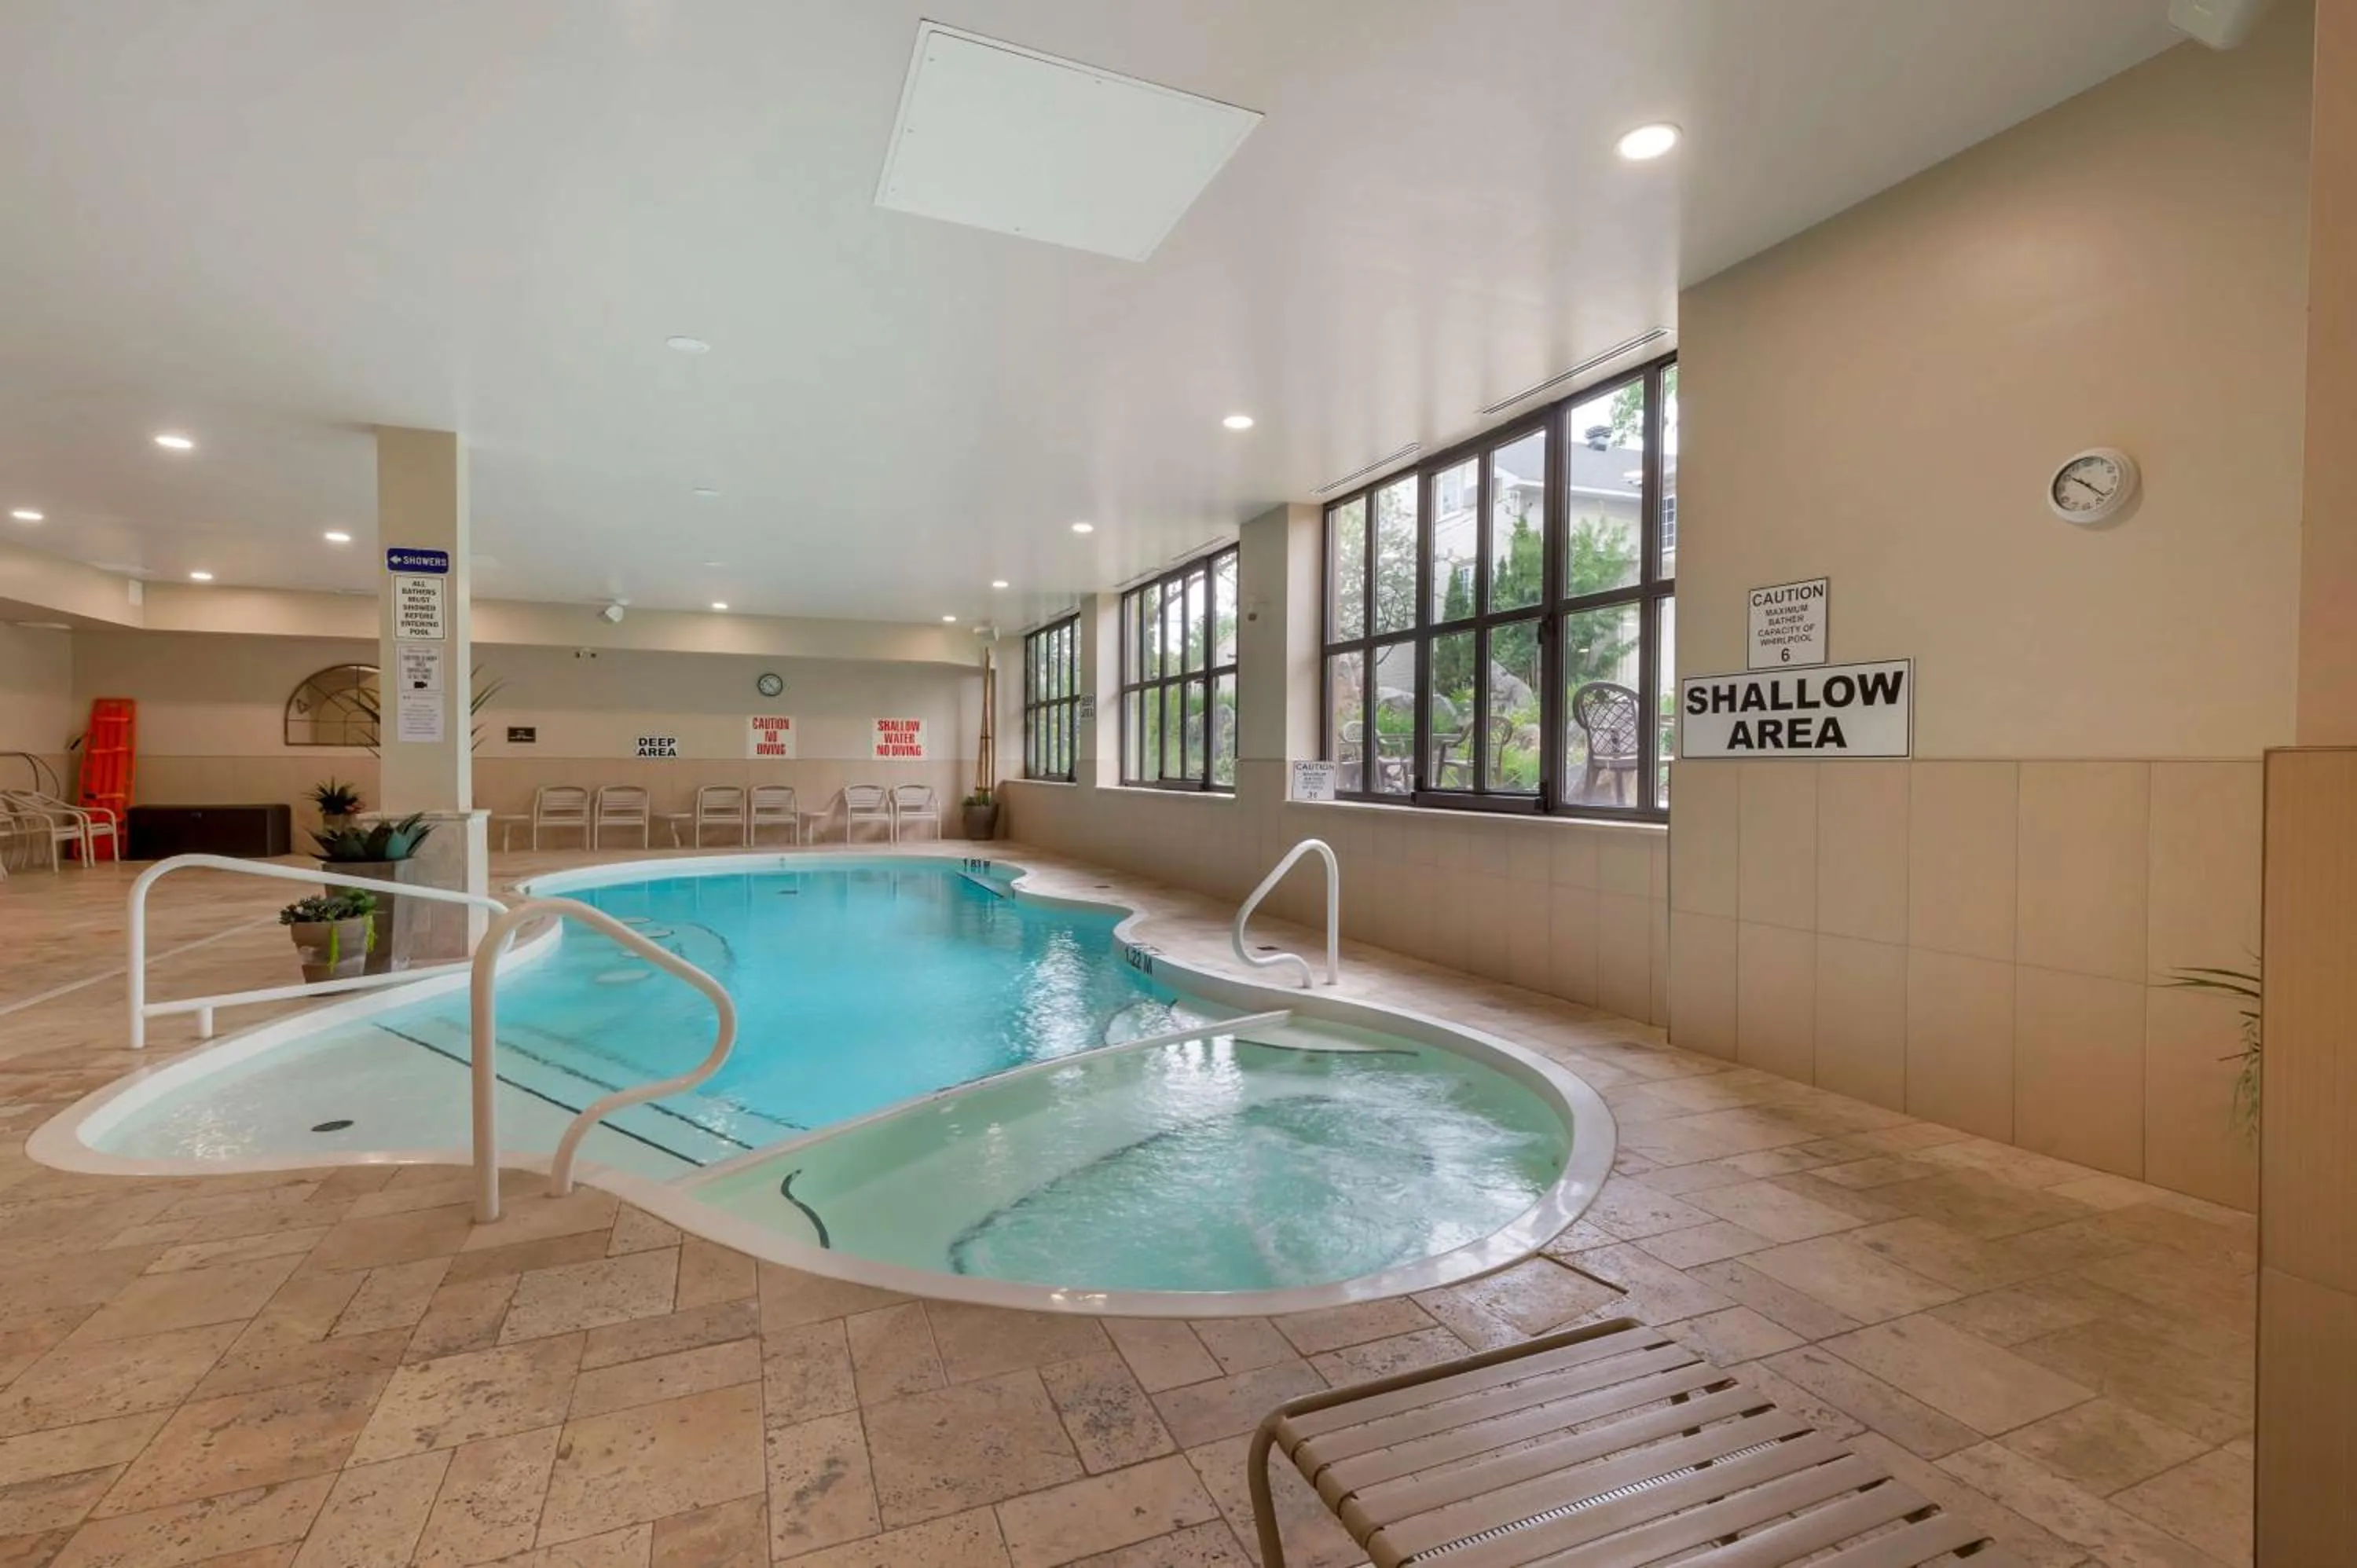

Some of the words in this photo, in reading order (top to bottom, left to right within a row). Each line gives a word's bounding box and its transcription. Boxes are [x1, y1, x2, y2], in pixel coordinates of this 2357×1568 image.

[403, 556, 447, 566] SHOWERS
[1752, 584, 1824, 607] CAUTION
[1765, 603, 1809, 617] MAXIMUM
[1769, 614, 1805, 626] BATHER
[1758, 625, 1802, 637] CAPACITY
[1802, 623, 1816, 633] OF
[1760, 634, 1813, 647] WHIRLPOOL
[1781, 647, 1791, 662] 6
[1686, 671, 1904, 716] SHALLOW
[752, 717, 790, 730] CAUTION
[878, 720, 920, 732] SHALLOW
[764, 730, 778, 742] NO
[884, 732, 915, 744] WATER
[1727, 716, 1848, 749] AREA
[638, 737, 676, 746] DEEP
[637, 747, 677, 757] AREA
[756, 742, 786, 756] DIVING
[877, 744, 890, 756] NO
[892, 744, 922, 756] DIVING
